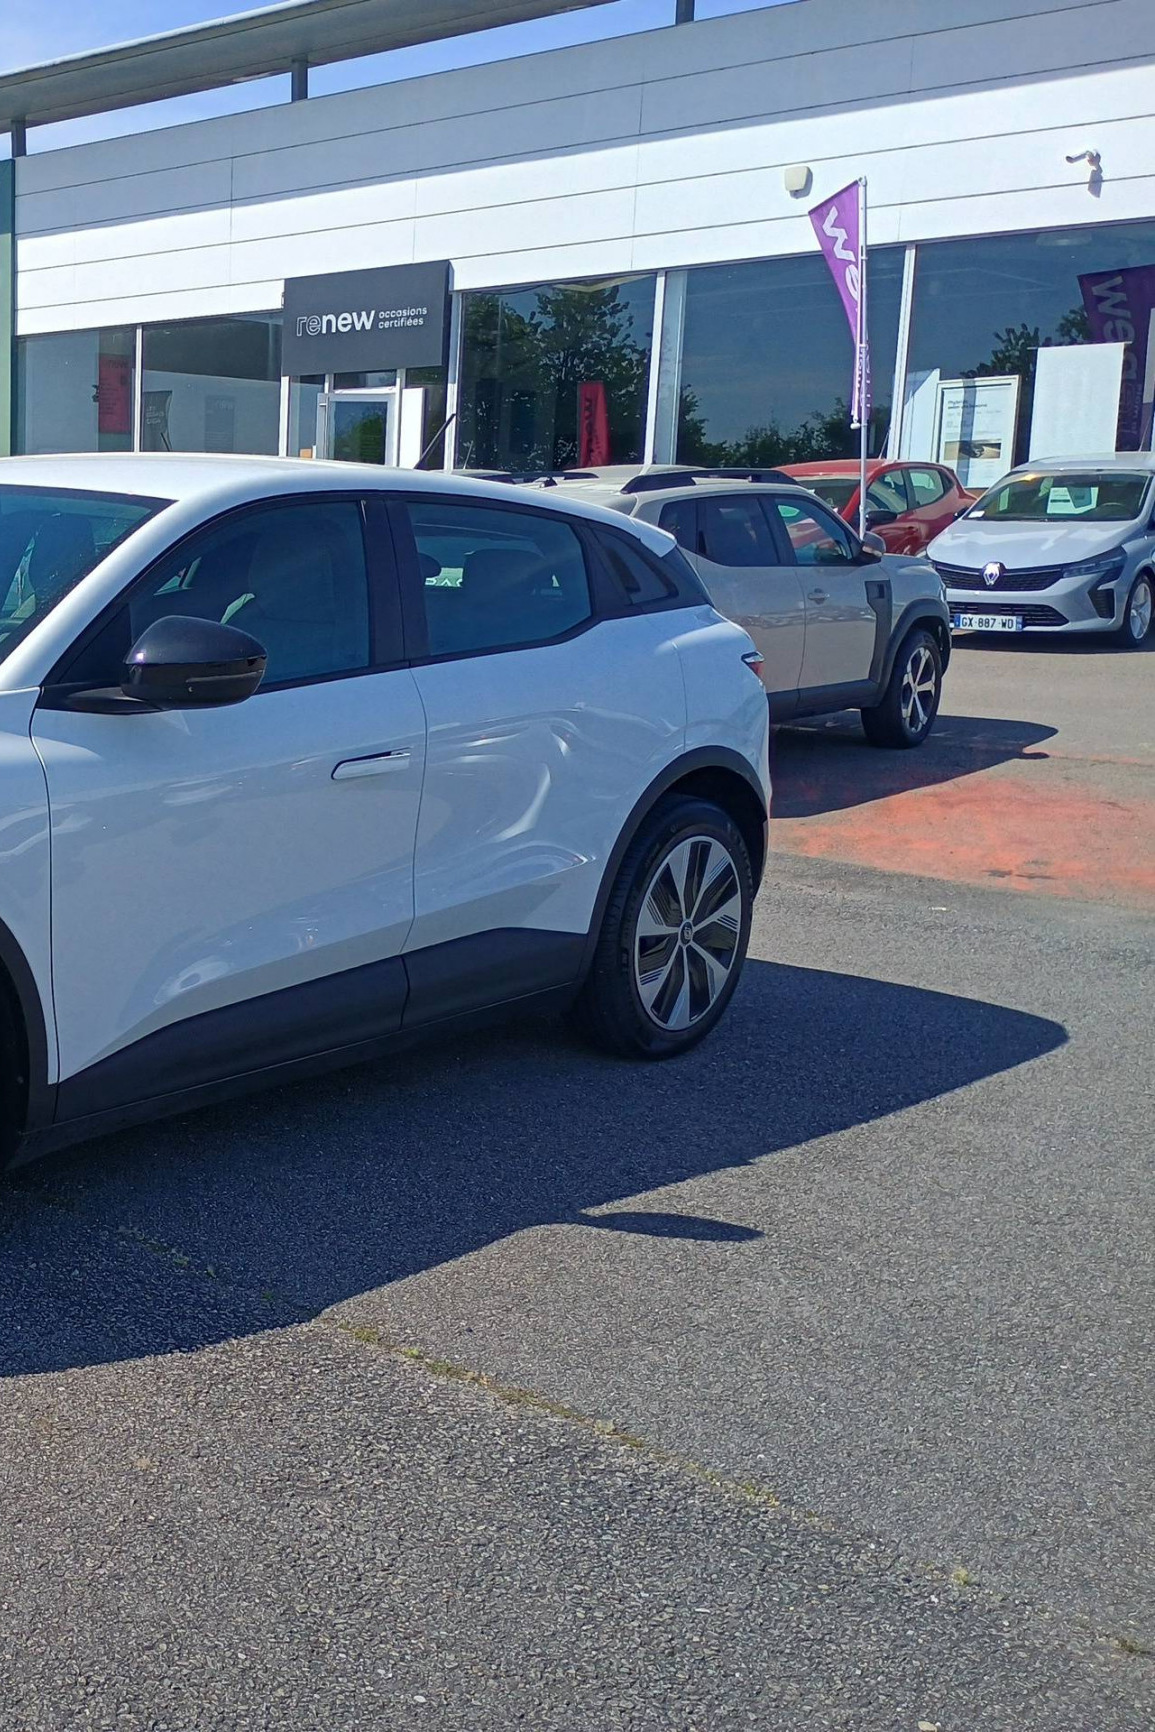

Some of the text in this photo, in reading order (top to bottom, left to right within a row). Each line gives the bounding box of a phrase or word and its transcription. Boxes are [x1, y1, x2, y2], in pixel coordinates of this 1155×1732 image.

[379, 306, 428, 319] occasions
[296, 310, 376, 337] renew
[379, 316, 424, 329] certifiées
